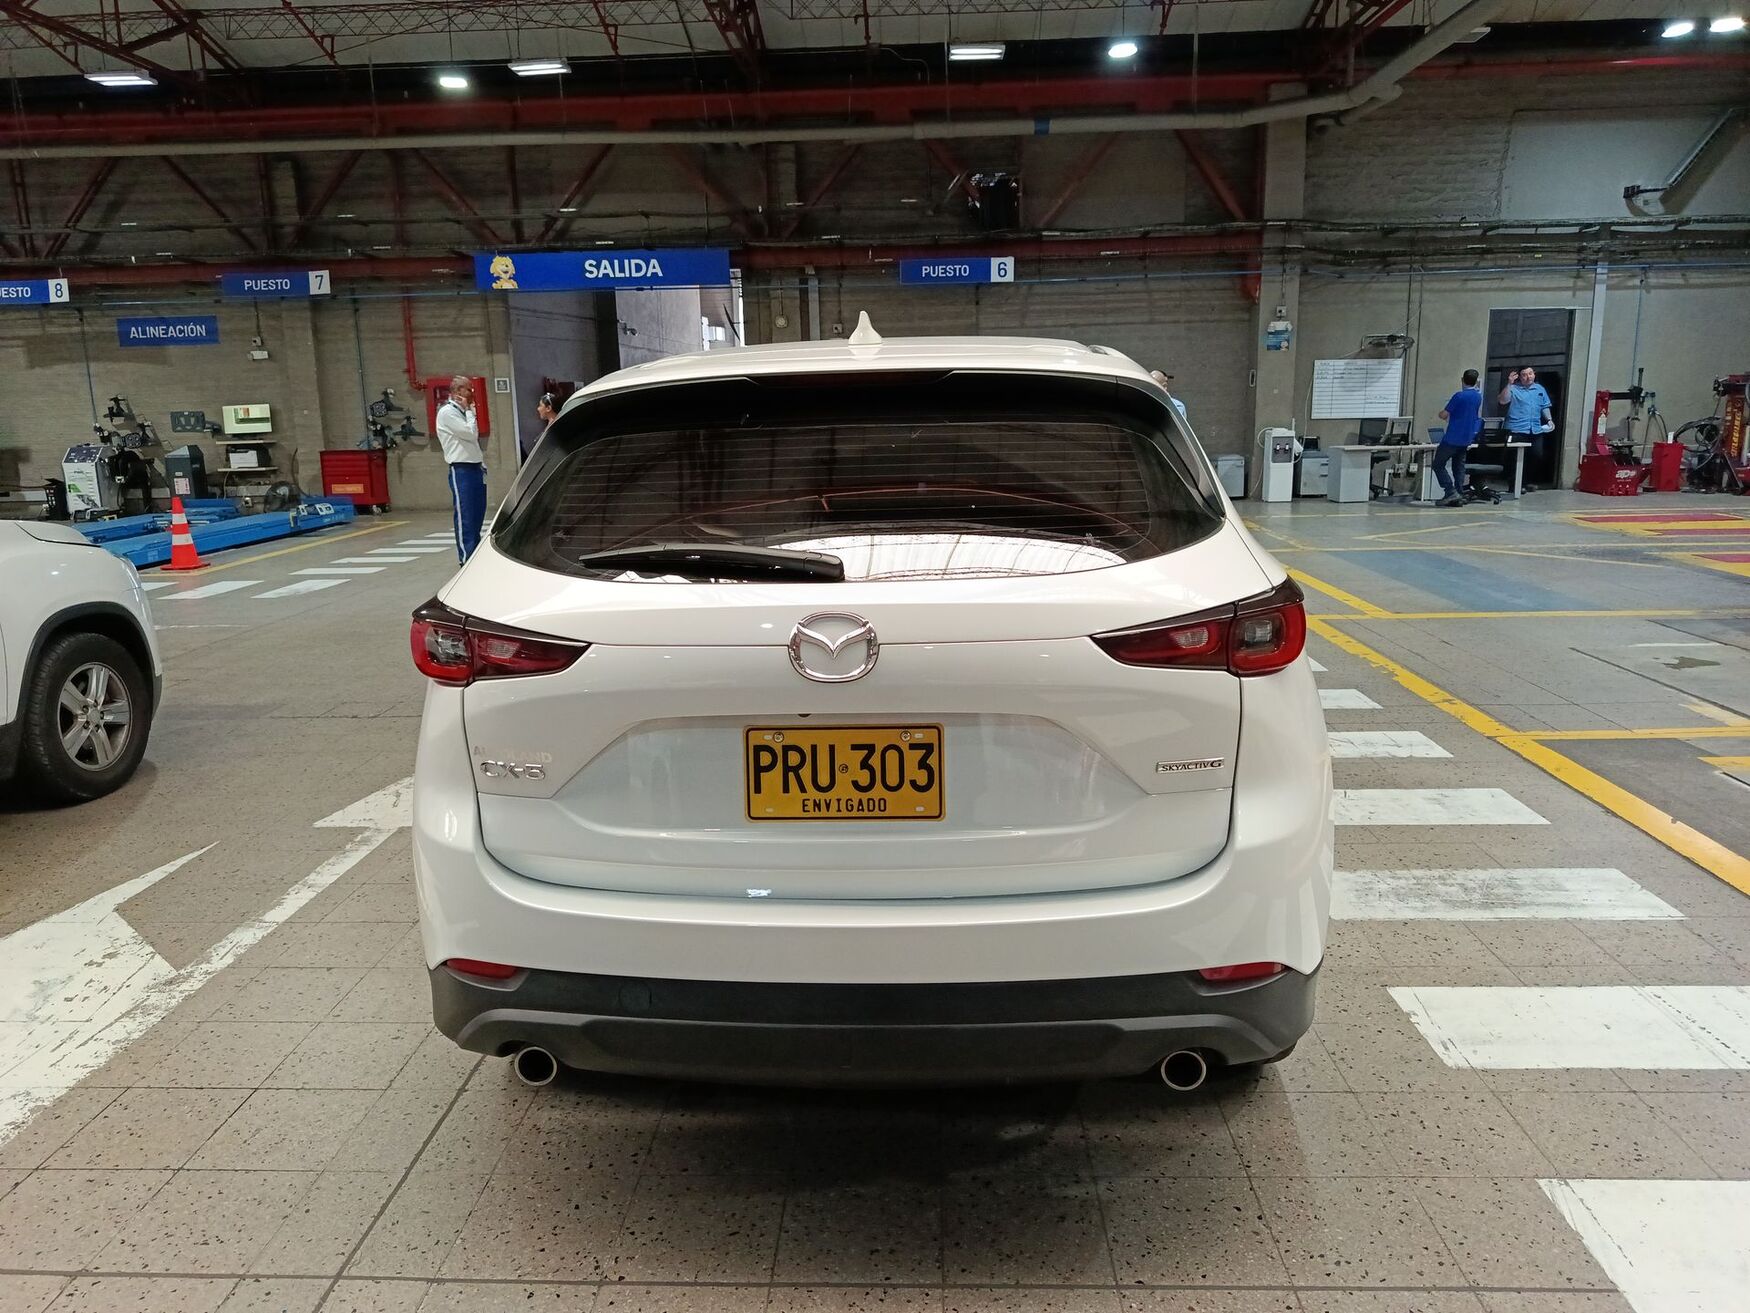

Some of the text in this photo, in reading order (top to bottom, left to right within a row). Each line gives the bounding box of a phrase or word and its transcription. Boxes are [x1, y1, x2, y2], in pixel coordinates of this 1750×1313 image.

[584, 258, 663, 279] SALIDA
[922, 261, 1008, 278] PUESTO 6
[0, 282, 64, 299] ESTO 8
[244, 274, 324, 291] PUESTO 7
[129, 322, 206, 339] ALINEACIÓN
[480, 760, 545, 780] CX-5
[802, 797, 887, 813] ENVIGADO
